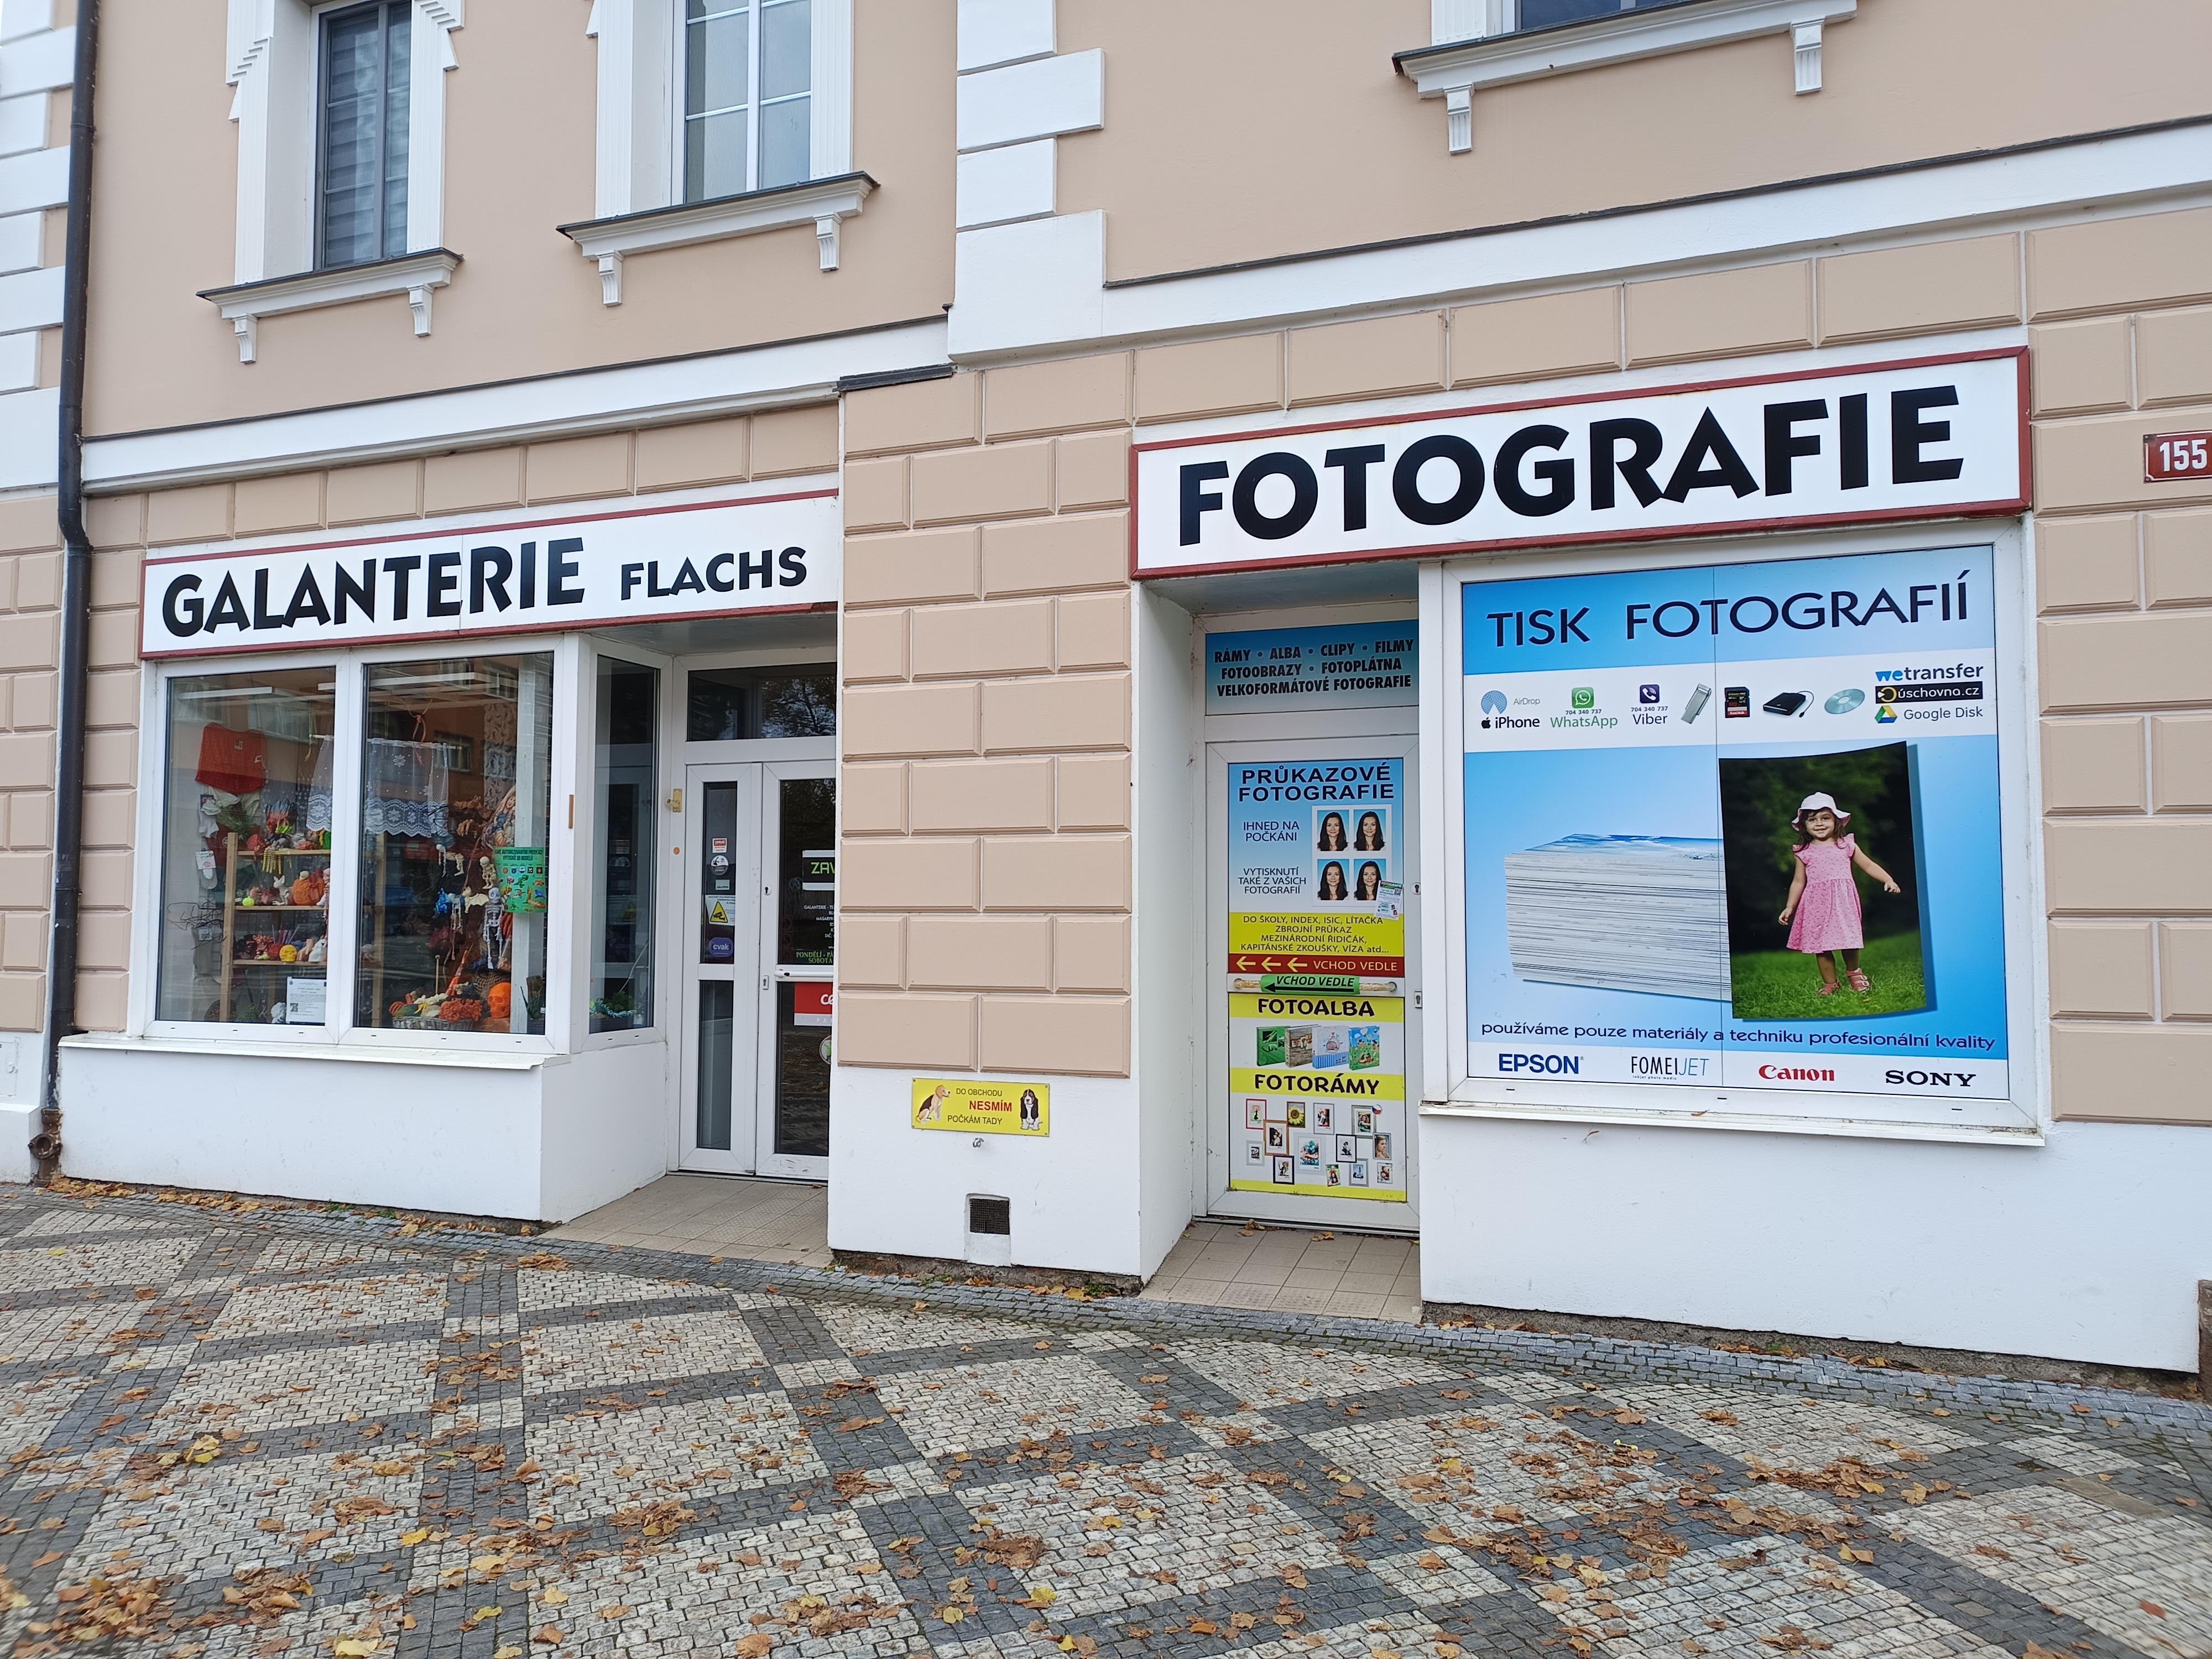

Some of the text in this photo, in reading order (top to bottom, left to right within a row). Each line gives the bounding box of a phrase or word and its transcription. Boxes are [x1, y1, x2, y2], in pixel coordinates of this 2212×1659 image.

[2159, 439, 2207, 472] 155
[1178, 384, 1964, 546] FOTOGRAFIE
[162, 538, 806, 637] GALANTERIE FLACHS
[1486, 569, 1971, 648] TISK FOTOGRAFIÍ
[1214, 639, 1414, 662] RÁMY ALBA CLIPY FILMY
[1221, 656, 1401, 680] FOTOOBRAZY FOTOPLÁTNA
[1875, 664, 1984, 681] wetransfer
[1217, 675, 1411, 697] VELKOFORMÁTOVÉ FOTOGRAFIE
[1632, 713, 1668, 725] Viber
[1904, 706, 1983, 721] Google Disk
[1495, 717, 1540, 729] iPhone
[1551, 716, 1618, 729] WhatsApp
[1242, 761, 1390, 784] PRŮKAZOVÉ
[1239, 784, 1394, 802] FOTOGRAFIE
[1244, 821, 1300, 831] IHNED NA
[1246, 831, 1297, 841] POČKÁNI
[1243, 867, 1299, 875] VYTISKNUTÍ
[1238, 877, 1261, 885] TAKÉ
[1272, 876, 1306, 885] VAŠICH
[1244, 885, 1300, 894] FOTOGRAFIÍ
[1260, 915, 1288, 924] ŠKOLY,
[1291, 916, 1321, 925] INDEX,
[1324, 916, 1343, 925] ISIC,
[1346, 915, 1383, 924] LÍTAČKA
[1275, 925, 1352, 933] ZBROJNÍ PRŮKAZ
[1261, 934, 1367, 944] MEZINÁRODNÍ ŘIDIČÁK,
[1240, 943, 1293, 951] KAPITÁNSKÉ
[1296, 944, 1339, 953] ZKOUŠKY,
[1343, 944, 1364, 952] VÍZA
[1313, 961, 1397, 971] VCHOD VEDLE
[1276, 975, 1355, 987] VCHOD VEDLE
[1258, 998, 1375, 1017] FOTOALBA
[1482, 1022, 1995, 1051] používáme pouze materiály a techniku profesionální kvality
[1499, 1053, 1579, 1074] EPSON
[1759, 1065, 1835, 1081] Canon
[1886, 1070, 1976, 1087] SONY
[1255, 1073, 1379, 1095] FOTORÁMY
[968, 1088, 1002, 1097] OBCHODU
[969, 1100, 1012, 1112] NESMÍM
[947, 1114, 980, 1124] POČKÁM
